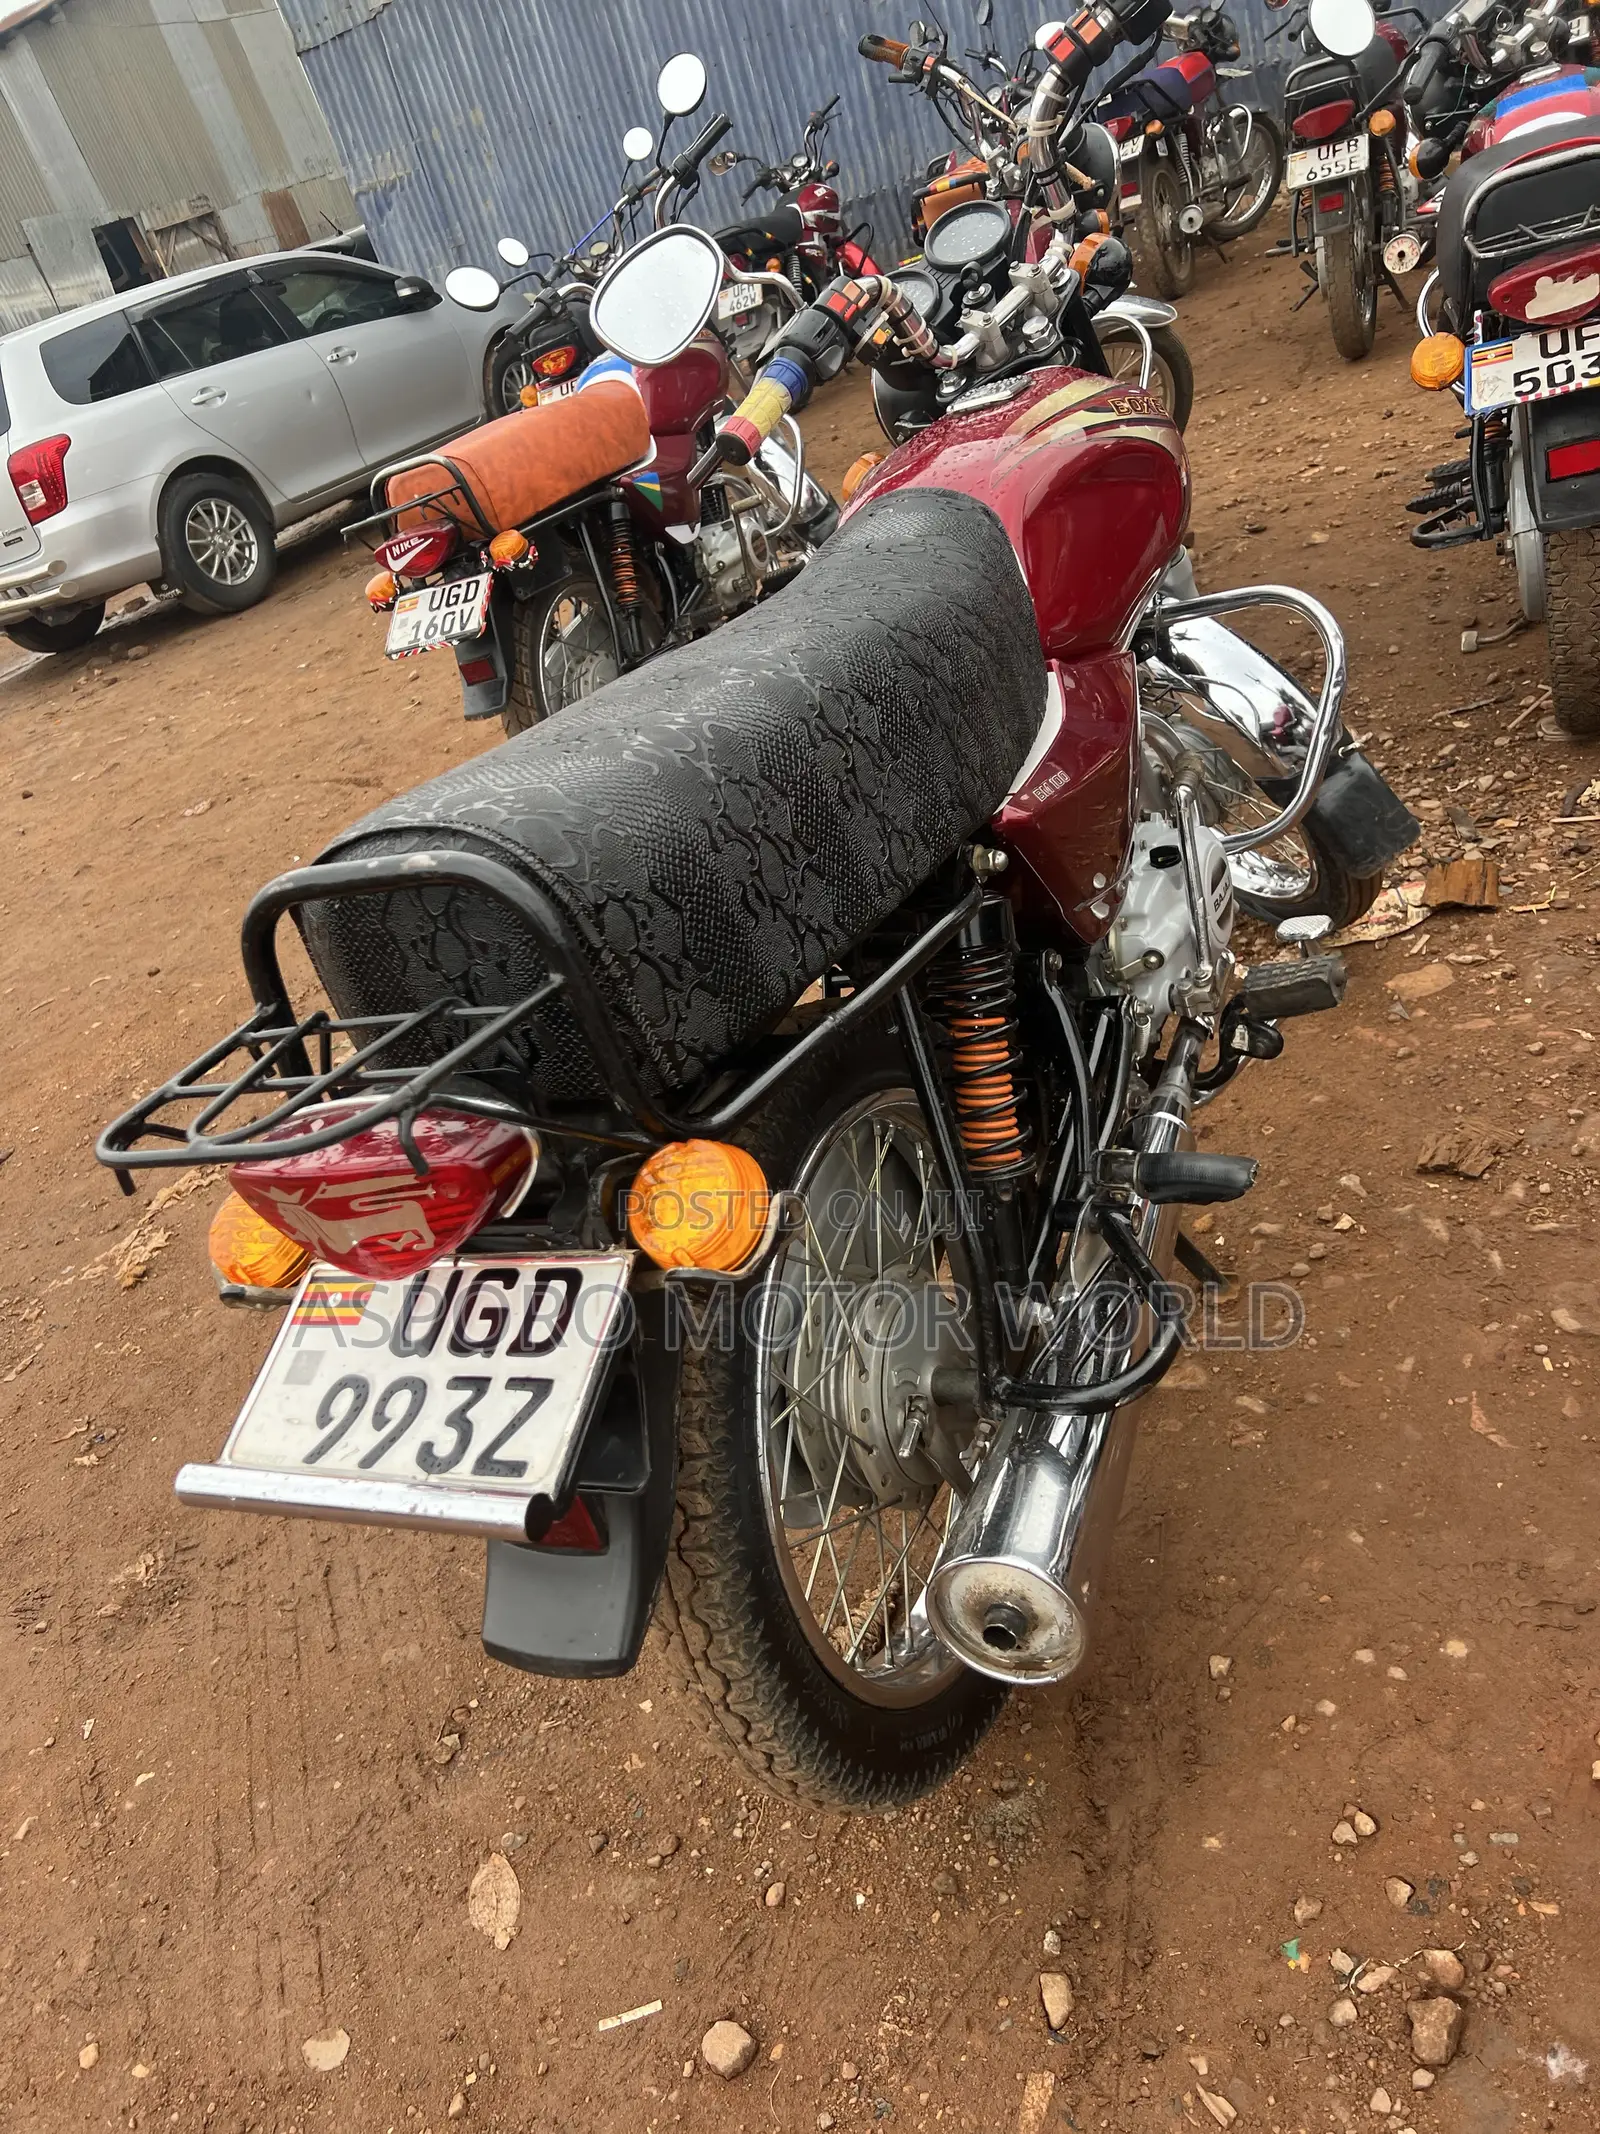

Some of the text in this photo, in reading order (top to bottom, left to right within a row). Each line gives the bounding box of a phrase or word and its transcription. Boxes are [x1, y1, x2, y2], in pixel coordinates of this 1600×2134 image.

[1317, 138, 1359, 161] UFB
[1306, 155, 1360, 182] 655E
[1513, 351, 1600, 397] 503
[391, 537, 425, 557] NIKE
[429, 580, 480, 612] UGD
[408, 606, 475, 646] 160V
[1032, 770, 1071, 803] BM 100
[389, 1266, 584, 1359] UGD
[303, 1373, 555, 1477] 993Z
